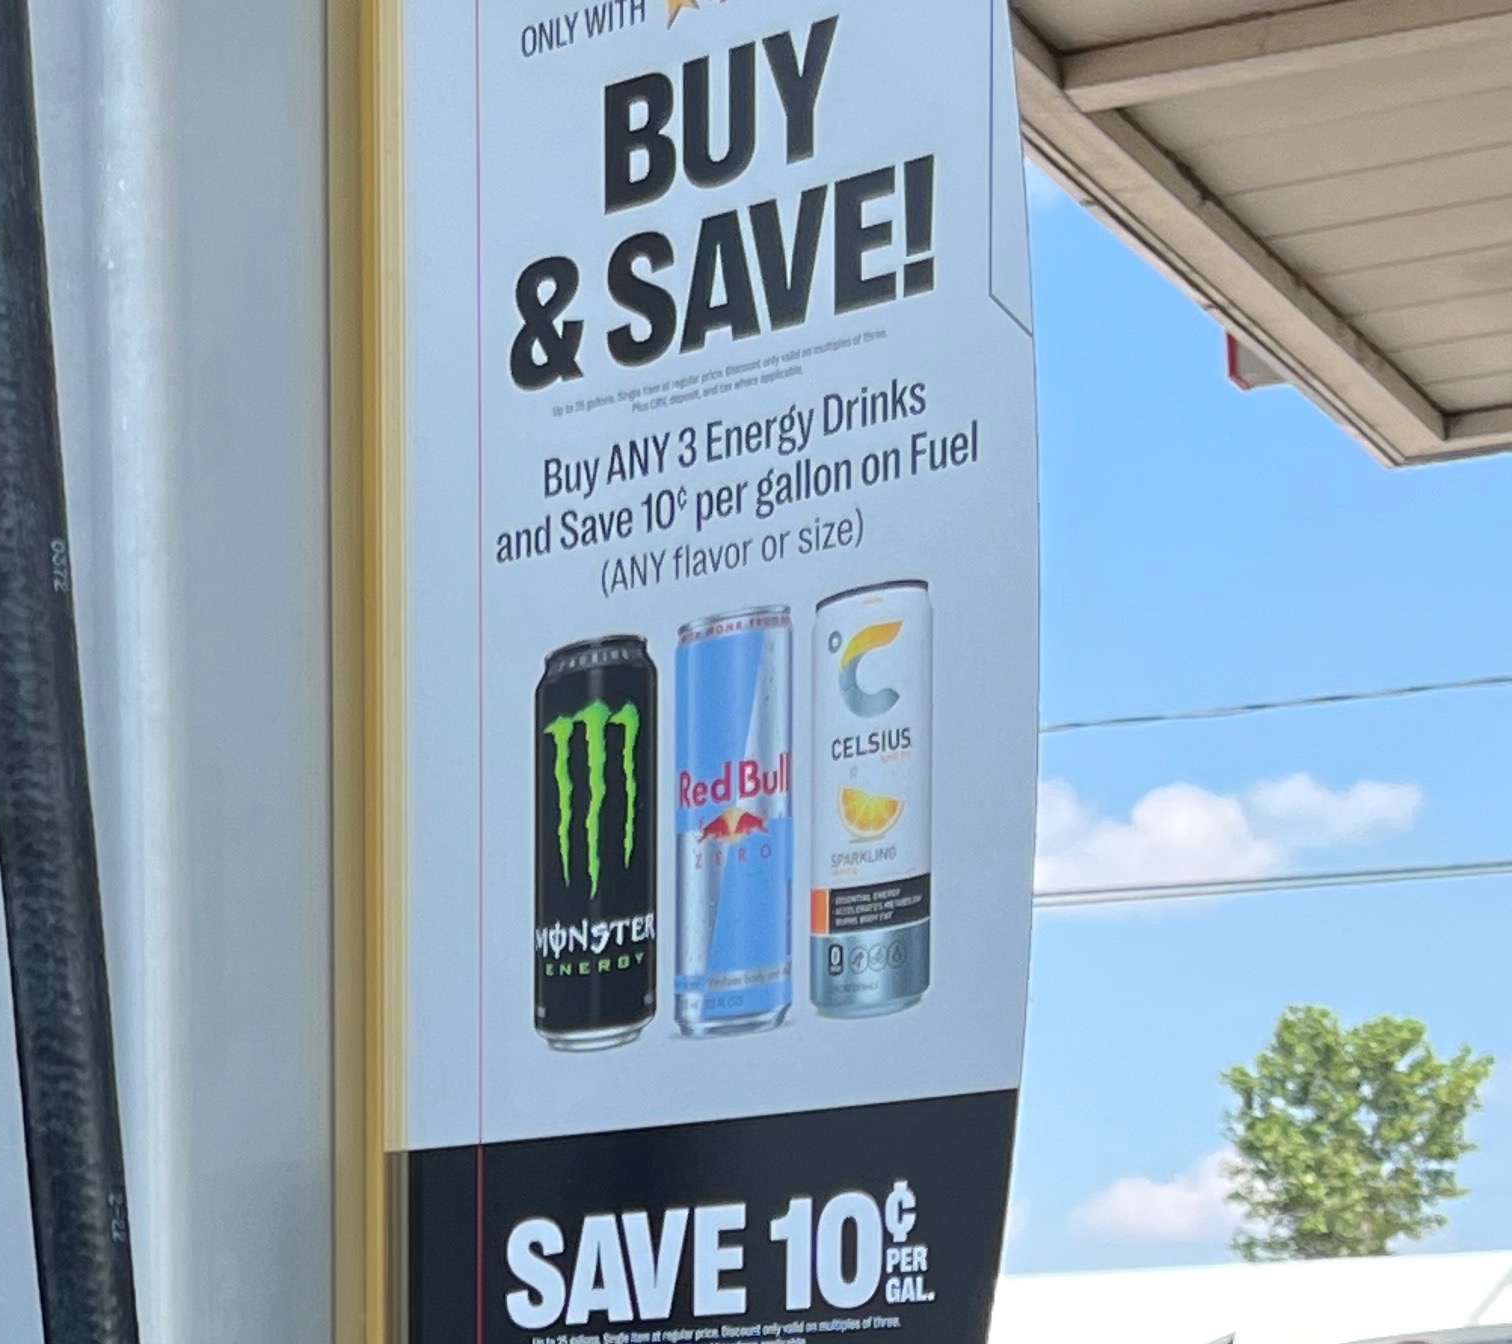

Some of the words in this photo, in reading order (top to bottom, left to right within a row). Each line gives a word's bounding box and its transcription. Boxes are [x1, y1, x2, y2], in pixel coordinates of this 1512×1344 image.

[521, 12, 580, 59] ONLY
[584, 0, 646, 40] WITH
[604, 15, 839, 215] BUY
[509, 256, 584, 391] &
[606, 154, 934, 368] SAVE!
[543, 454, 604, 502] Buy
[606, 431, 672, 487] ANY
[678, 427, 698, 469] 3
[706, 404, 816, 459] Energy
[822, 381, 927, 436] Drinks
[496, 516, 551, 565] and
[558, 506, 634, 552] Save
[694, 483, 749, 532] per
[755, 455, 853, 519] gallon
[861, 448, 900, 487] on
[911, 420, 979, 474] Fuel
[601, 551, 674, 599] (ANY
[673, 534, 754, 581] flavor
[761, 529, 791, 562] or
[798, 509, 864, 556] size)
[831, 727, 911, 761] CELSIUS
[679, 762, 731, 809] Red
[739, 752, 789, 799] Bull
[695, 844, 772, 870] ZERO
[831, 844, 897, 868] SPARKLING
[536, 911, 655, 960] MONSTER
[546, 951, 645, 976] ENERGY
[506, 1202, 748, 1329] SAVE
[886, 1246, 928, 1274] PER
[885, 1276, 936, 1303] GAL.
